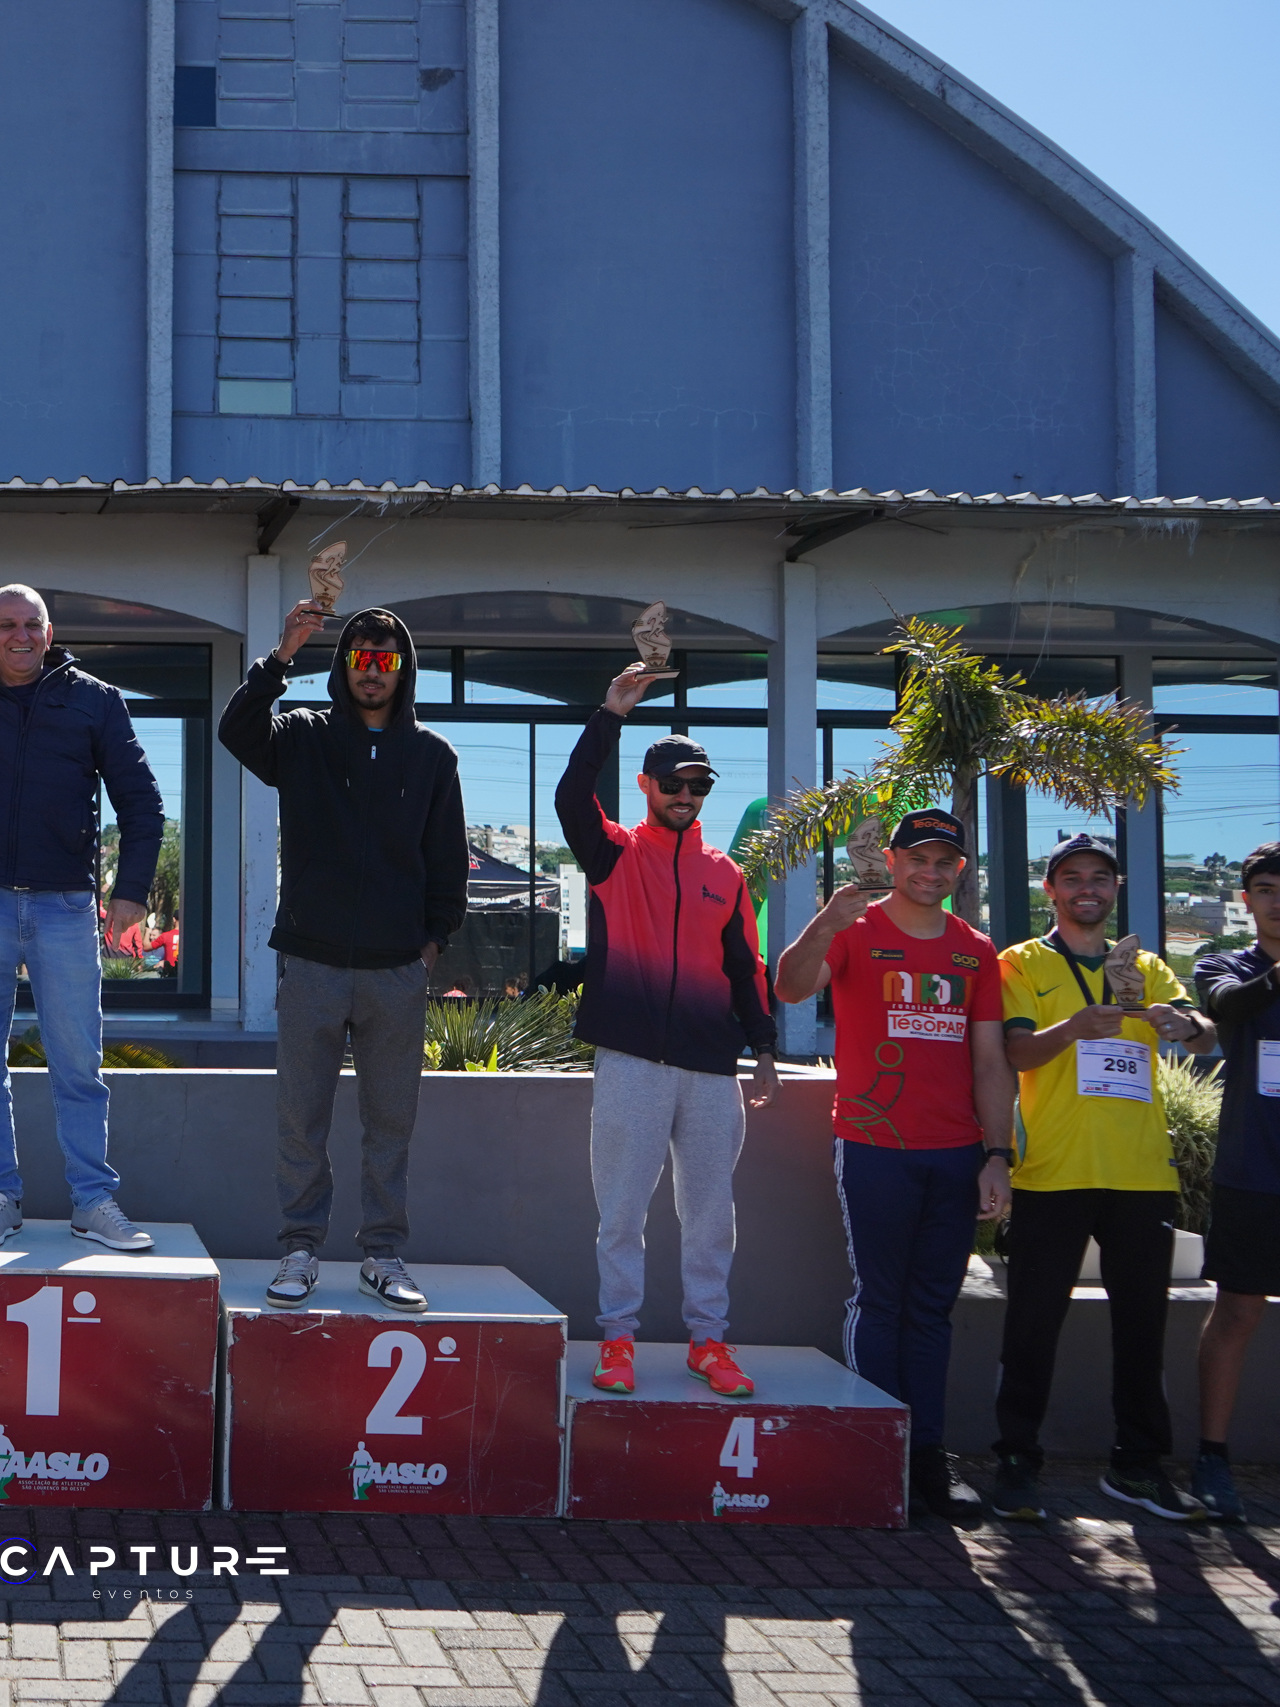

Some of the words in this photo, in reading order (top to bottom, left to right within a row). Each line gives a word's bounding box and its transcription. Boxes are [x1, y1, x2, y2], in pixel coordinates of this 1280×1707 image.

[951, 953, 979, 967] GOD
[892, 1003, 935, 1013] running
[941, 1005, 964, 1014] team
[1103, 1057, 1138, 1075] 298
[1, 1450, 109, 1481] AASLO
[363, 1461, 448, 1486] AASLO
